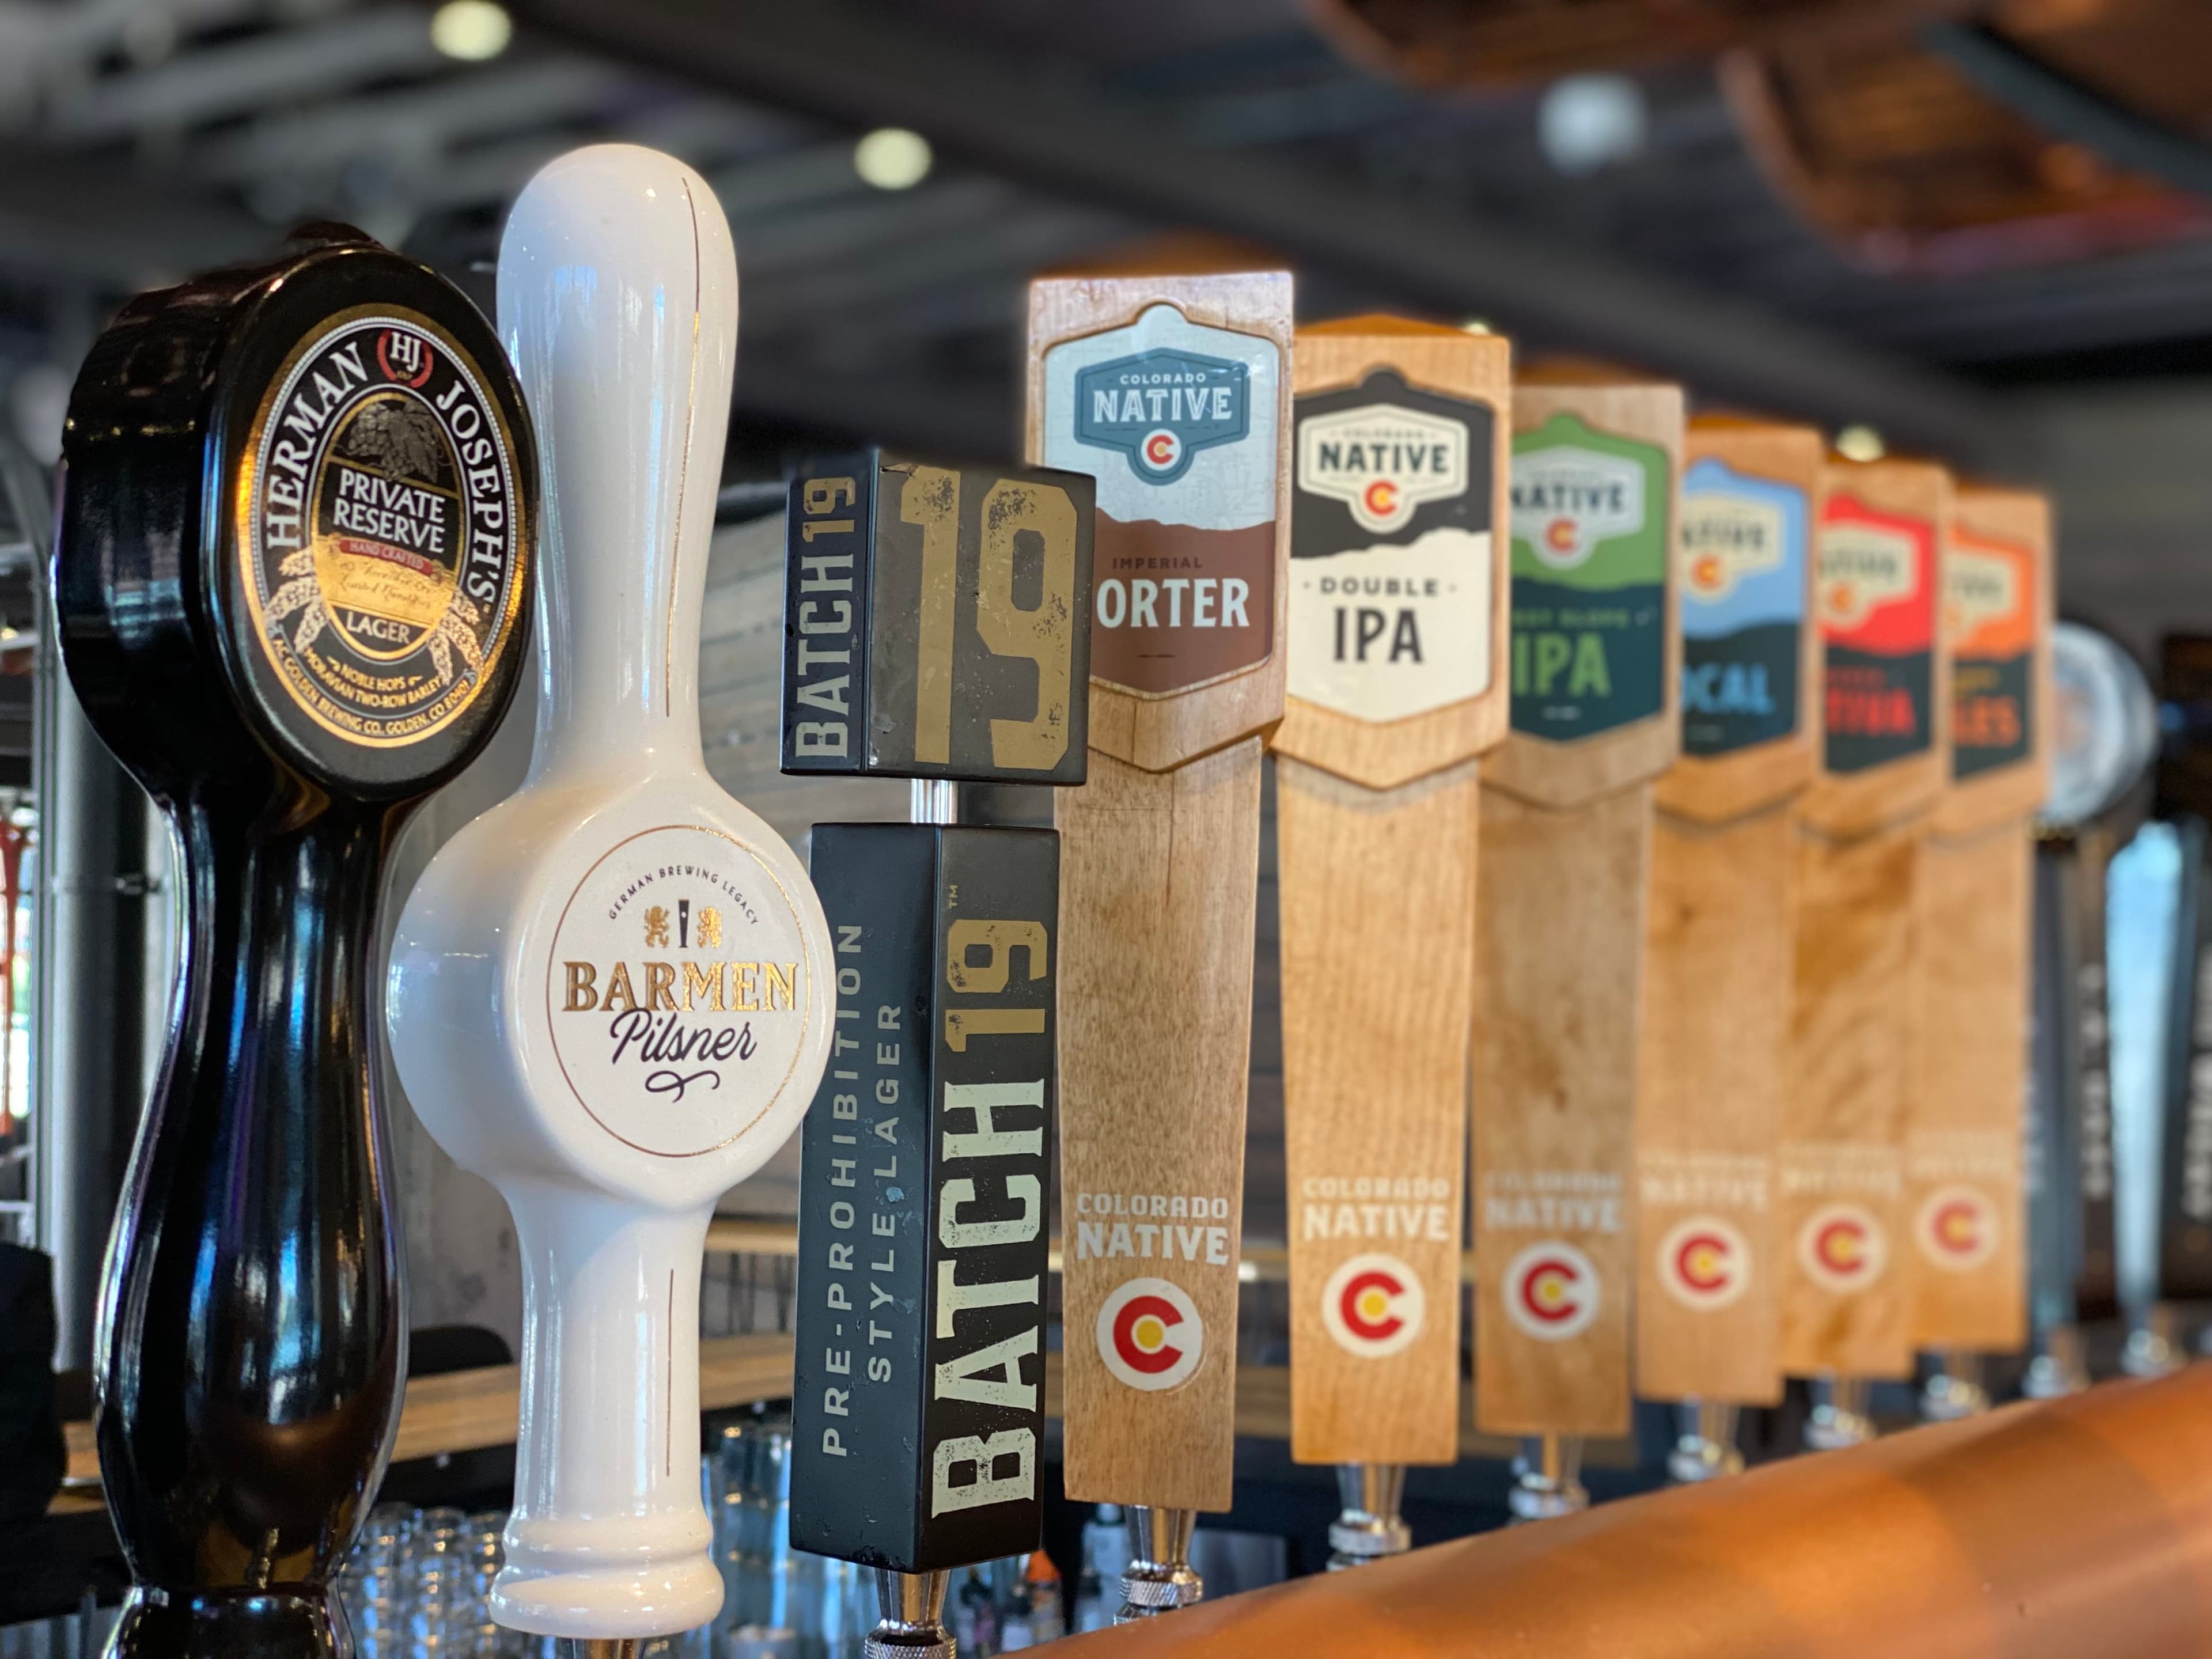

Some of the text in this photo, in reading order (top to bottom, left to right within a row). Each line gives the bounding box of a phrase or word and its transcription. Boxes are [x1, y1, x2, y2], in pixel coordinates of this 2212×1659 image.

[389, 332, 421, 373] HJ
[1119, 373, 1207, 385] COLORADO
[1093, 387, 1233, 423] NATIVE
[266, 341, 504, 604] HERMAN JOSEPH'S
[1319, 442, 1449, 474] NATIVE
[339, 468, 445, 523] PRIVATE
[333, 498, 445, 553] RESERVE
[349, 541, 425, 570] HAND CRAFTED
[1112, 557, 1203, 570] IMPERIAL
[1096, 578, 1249, 628] ORTER
[1320, 577, 1440, 597] DOUBLE
[346, 611, 411, 644] LAGER
[796, 476, 856, 758] BATCH 19
[900, 465, 1078, 771] 19
[1332, 606, 1425, 665] IPA
[1513, 632, 1613, 698] IPA
[608, 865, 759, 926] GERMAN BREWING LEGACY
[562, 961, 800, 1012] BARMEN
[945, 919, 1048, 1052] 19
[609, 1006, 757, 1065] Pilsner
[822, 926, 862, 1457] PRE-PROHIBITION
[868, 1005, 901, 1382] STYLE LAGER
[1076, 1192, 1229, 1219] COLORADO
[1301, 1176, 1452, 1201] COLORADO
[1076, 1222, 1229, 1266] NATIVE
[1302, 1203, 1452, 1242] NATIVE
[931, 1078, 1044, 1519] BATCH
